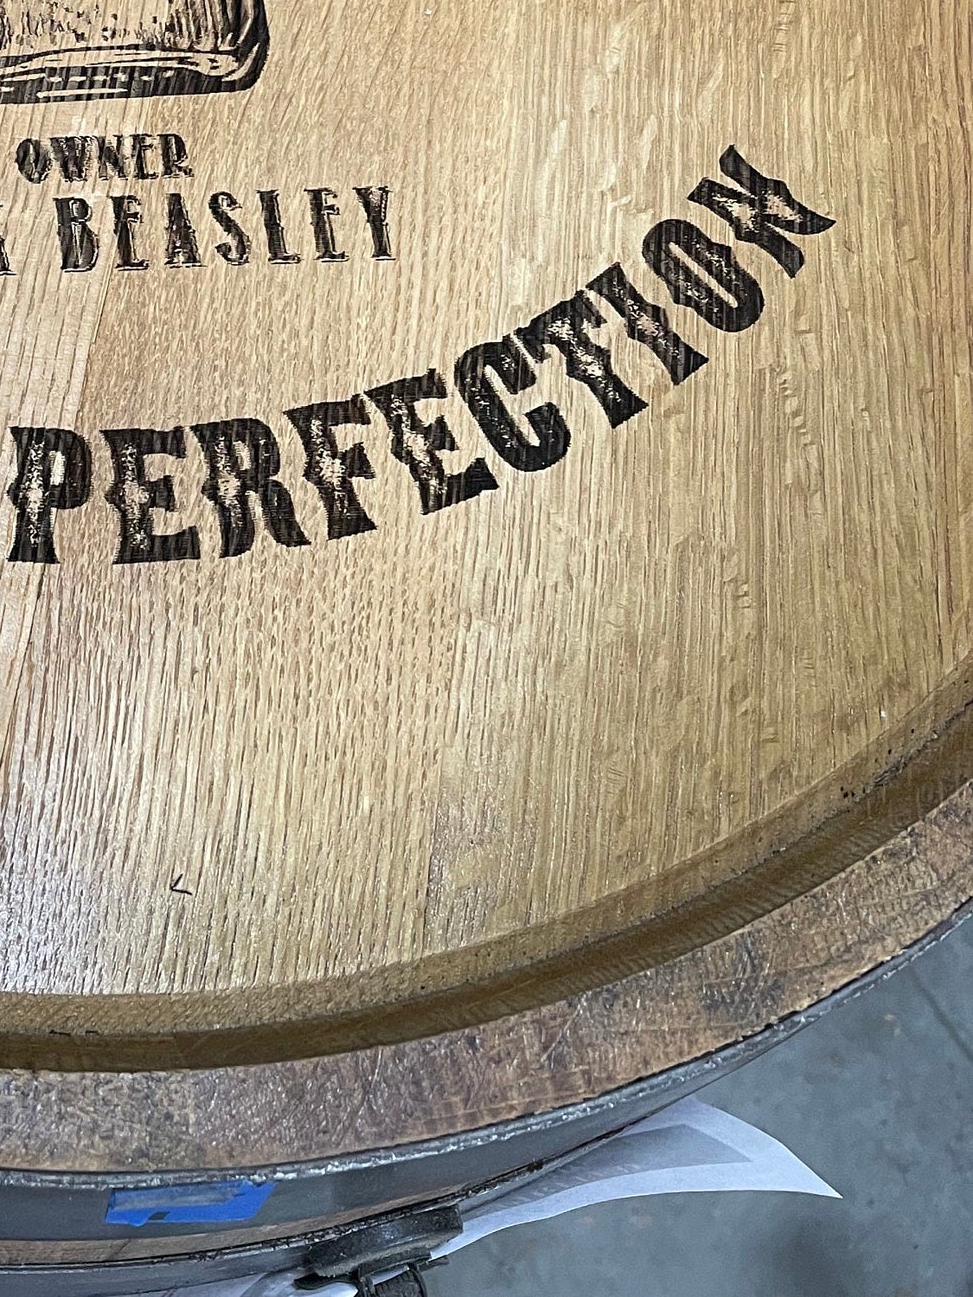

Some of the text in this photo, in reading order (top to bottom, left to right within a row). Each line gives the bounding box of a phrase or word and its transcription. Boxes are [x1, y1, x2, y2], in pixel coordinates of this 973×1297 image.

[15, 133, 193, 184] OWNER
[52, 186, 398, 272] BEASLEY
[7, 144, 836, 565] PERFECTION
